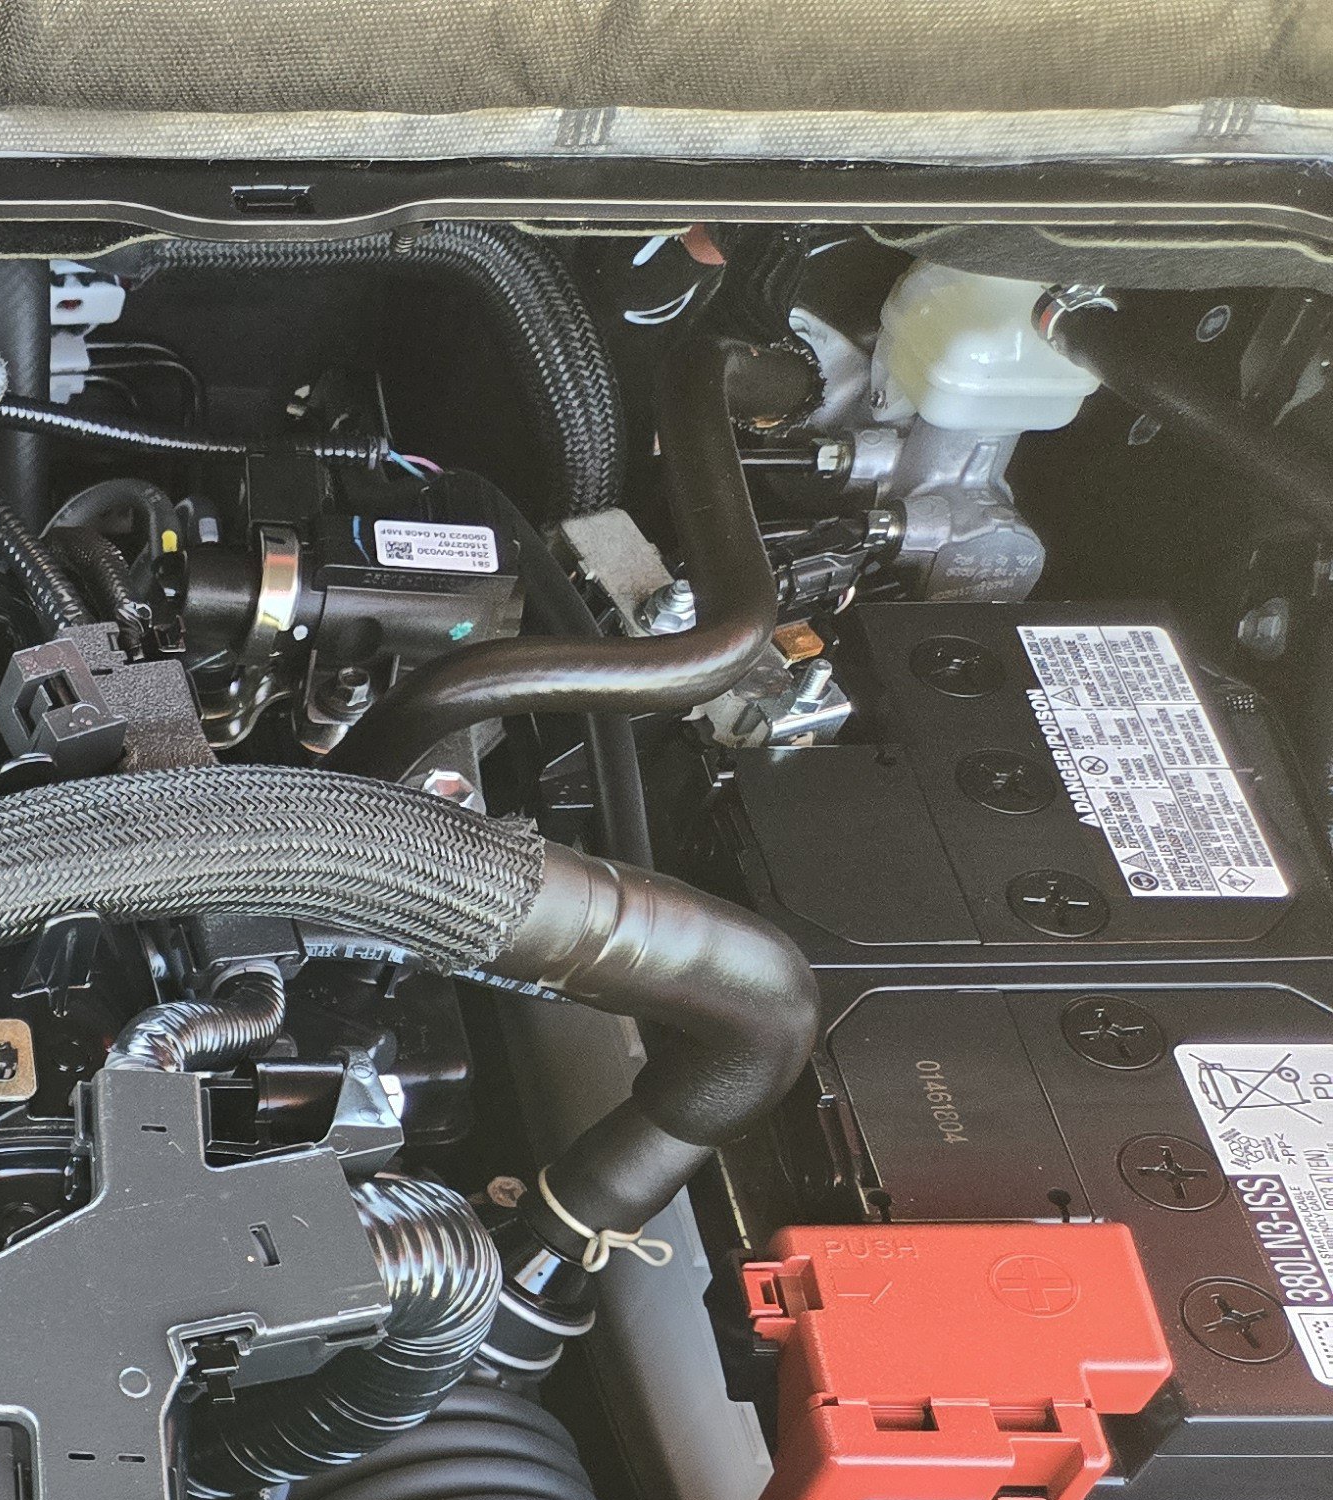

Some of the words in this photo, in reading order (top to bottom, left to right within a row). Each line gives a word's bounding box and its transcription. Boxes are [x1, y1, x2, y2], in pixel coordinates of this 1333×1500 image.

[1026, 641, 1043, 655] ACID
[1127, 631, 1147, 652] GARDER
[1038, 637, 1060, 666] BLINDNESS
[1063, 640, 1092, 679] SULFURIQUE
[1033, 657, 1056, 685] SULFURIC
[1126, 656, 1141, 667] AND
[1091, 670, 1110, 690] CAUSER
[1132, 669, 1149, 684] TIGHT
[1140, 686, 1156, 700] CAPS
[1150, 681, 1165, 692] PAS
[1102, 693, 1117, 706] PEUT
[1116, 696, 1131, 706] DES
[1146, 717, 1160, 727] THE
[1081, 735, 1095, 745] LES
[1107, 735, 1122, 745] LES
[1155, 738, 1170, 749] OUT
[1181, 730, 1199, 746] HORS
[1196, 733, 1211, 743] DES
[1024, 689, 1094, 811] DANGER/POISON
[1161, 751, 1177, 764] KEEP
[1172, 746, 1191, 764] REACH
[1116, 758, 1136, 780] SPARKS
[1130, 758, 1150, 780] FLAMES
[1142, 754, 1164, 780] SMOKING
[1168, 775, 1185, 790] WITH
[1104, 791, 1124, 811] GASES
[1186, 788, 1203, 802] HELP
[1209, 781, 1235, 815] CONSULTEZ
[1129, 814, 1143, 822] OR
[1151, 800, 1174, 826] PEUVENT
[1176, 792, 1204, 830] IMMEDIATELY
[1193, 805, 1215, 829] MEDICAL
[1114, 814, 1141, 848] EXPLOSIVE
[1212, 816, 1230, 831] YEUX
[1106, 826, 1127, 848] SHIELD
[1133, 824, 1158, 856] BLINDNESS
[1163, 828, 1190, 863] EXPLOSIFS
[1194, 832, 1211, 846] EYES
[1206, 832, 1221, 842] GET
[1220, 833, 1235, 843] LES
[1157, 845, 1174, 855] LES
[1201, 847, 1220, 866] FLUSH
[1148, 859, 1168, 877] CAUSE
[1180, 865, 1197, 877] GAZ
[1193, 865, 1215, 890] BLESSER
[1157, 879, 1173, 890] CAN
[1186, 879, 1203, 890] LES
[1304, 1073, 1333, 1099] Pb
[915, 1059, 969, 1144] 01461804
[1272, 1132, 1299, 1164] >PP<
[1300, 1149, 1333, 1170] (EN)
[1288, 1185, 1320, 1232] APPLICABLE
[1302, 1190, 1322, 1210] CARS
[1231, 1176, 1333, 1302] 380LN3-ISS
[1310, 1233, 1331, 1258] START
[823, 1239, 919, 1259] PUSH
